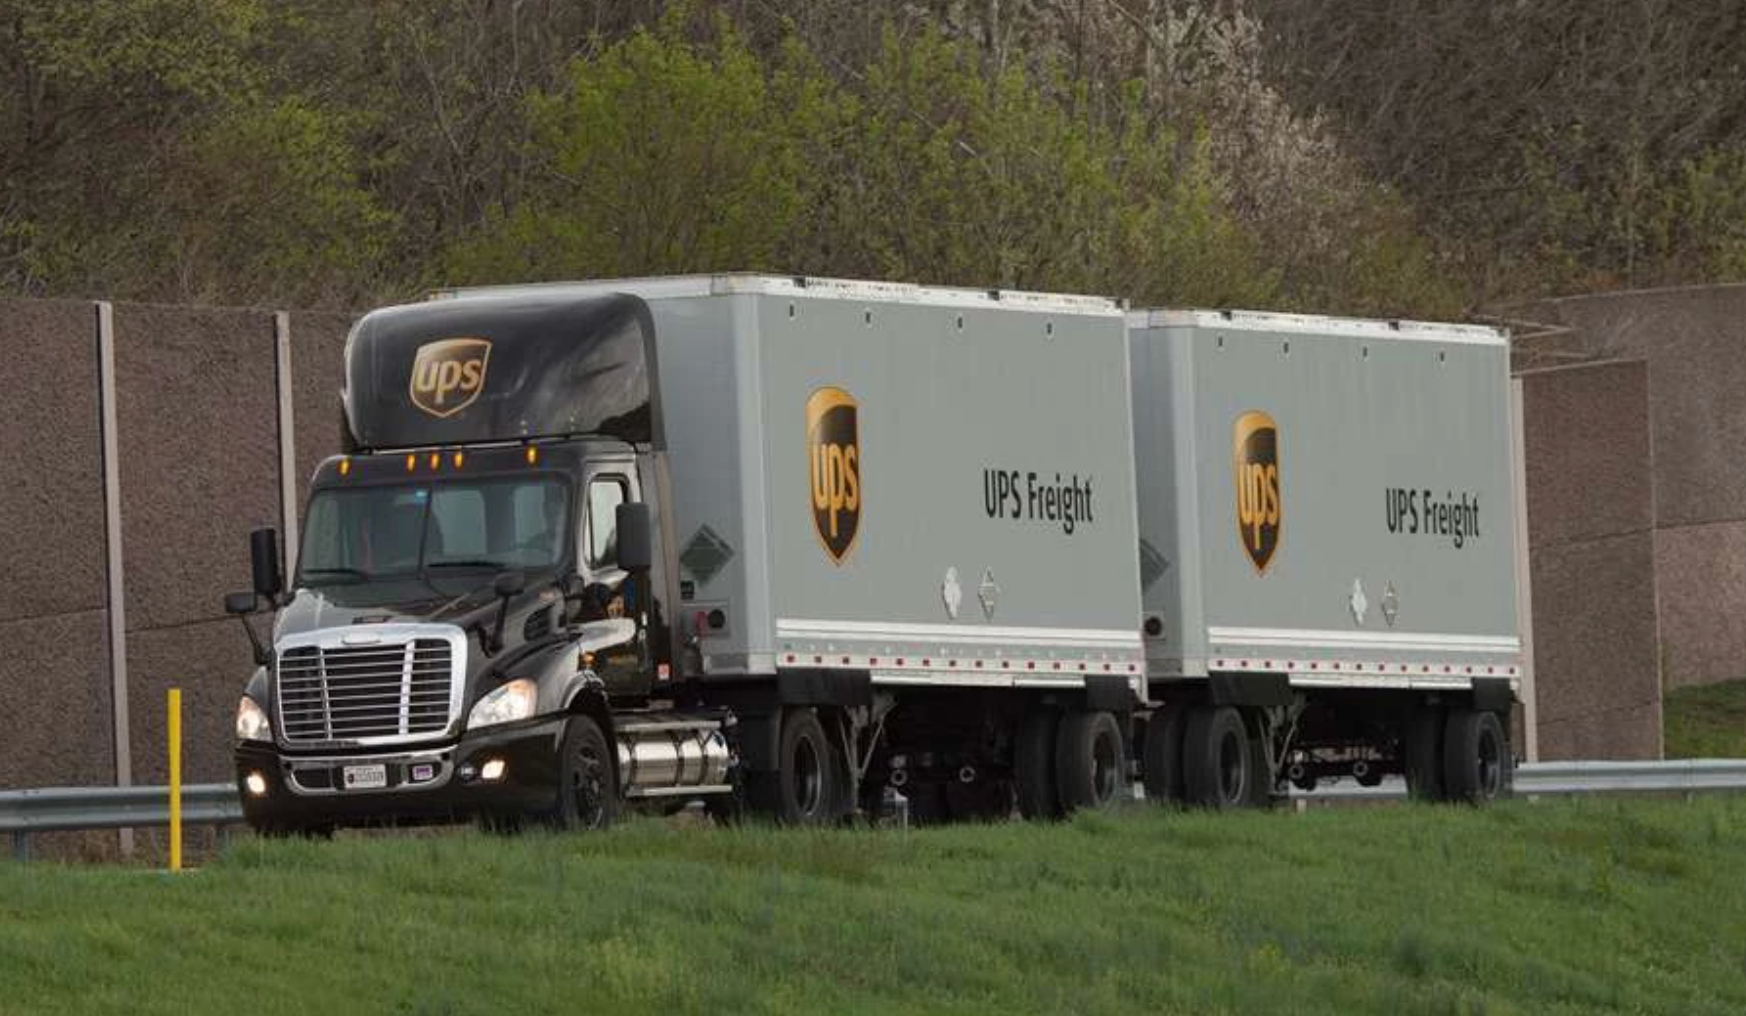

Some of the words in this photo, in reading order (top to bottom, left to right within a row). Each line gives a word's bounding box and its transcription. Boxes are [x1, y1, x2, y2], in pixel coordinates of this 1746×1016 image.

[415, 360, 481, 404] ups
[812, 443, 857, 536] ups
[984, 468, 1021, 518] UPS
[1027, 472, 1093, 535] Freight
[1239, 463, 1278, 549] ups
[1386, 488, 1418, 533] UPS
[1424, 490, 1479, 549] Freight
